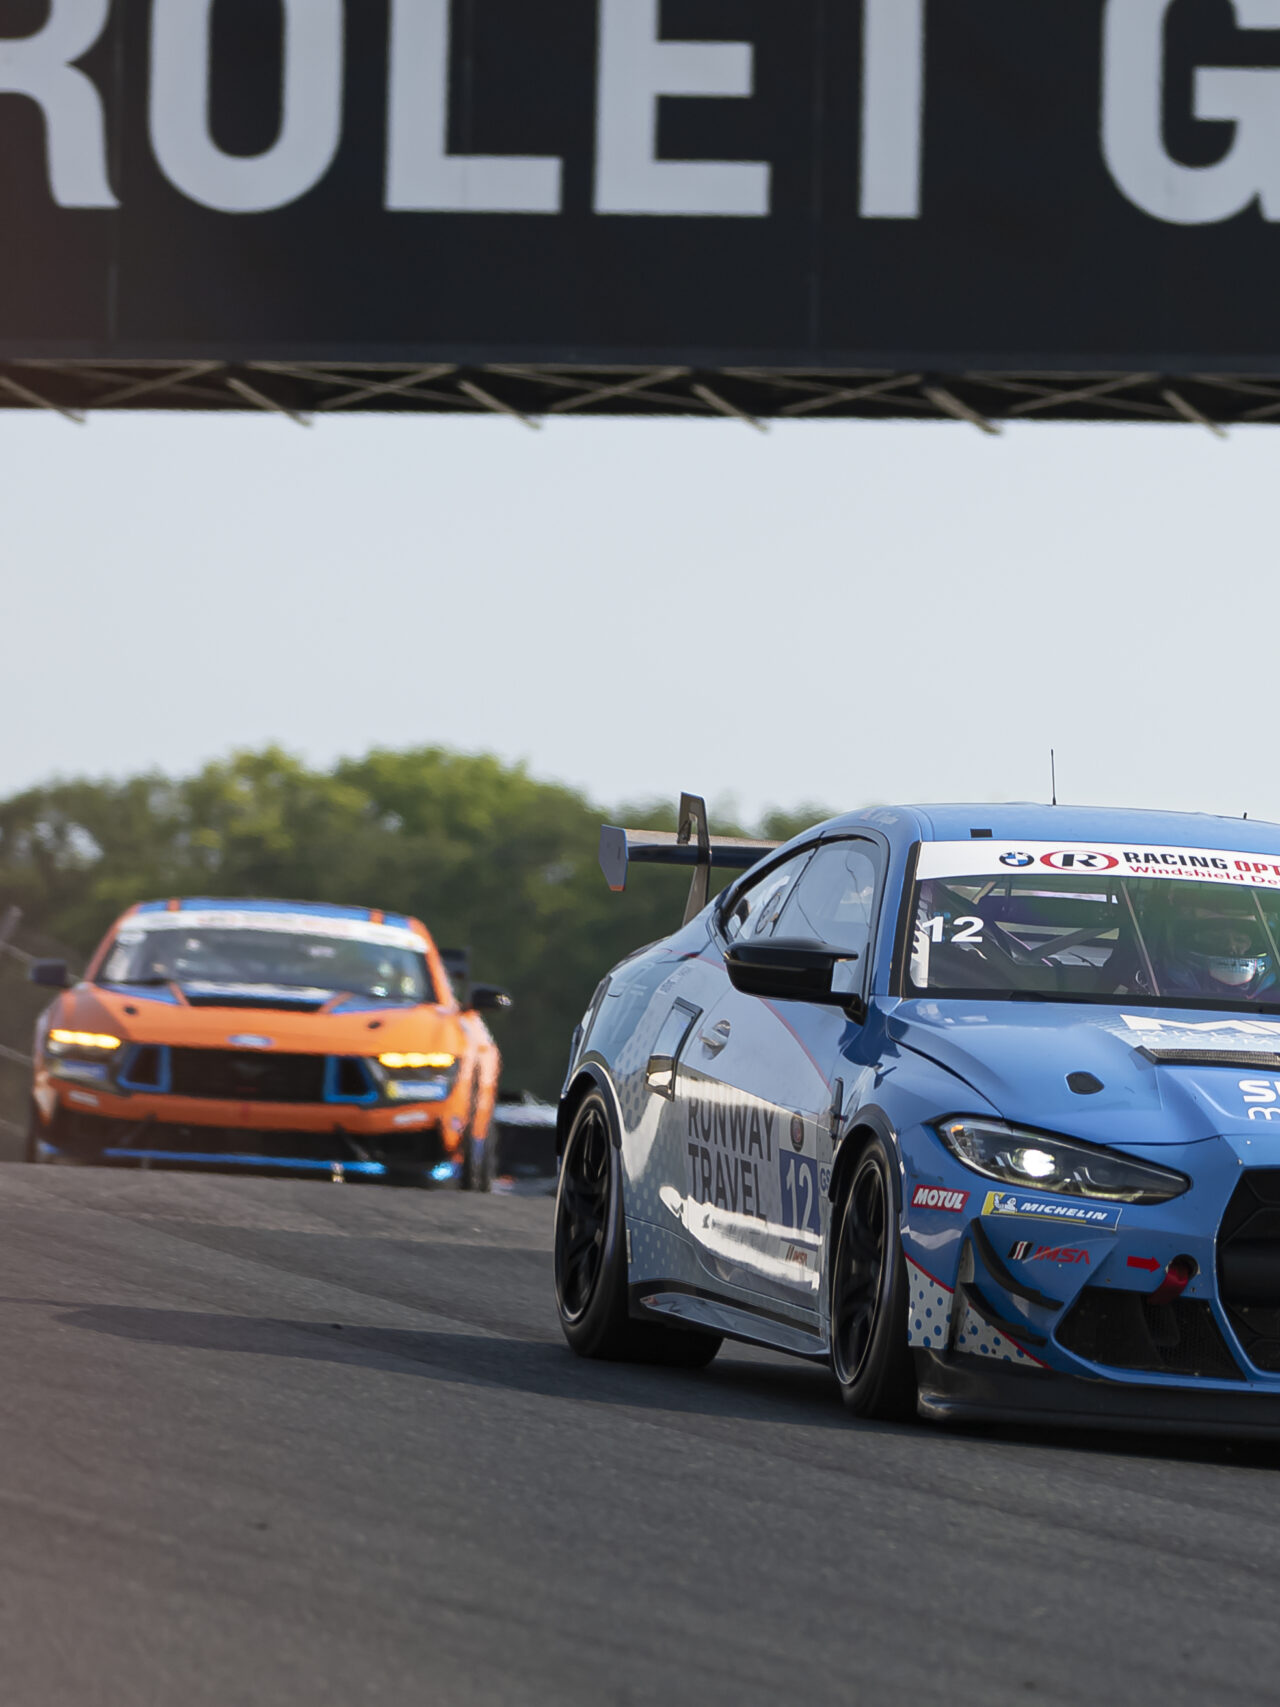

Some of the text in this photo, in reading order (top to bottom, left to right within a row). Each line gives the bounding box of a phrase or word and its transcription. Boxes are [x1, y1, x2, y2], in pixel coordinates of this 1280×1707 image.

[1123, 852, 1228, 869] RACING
[1129, 865, 1244, 881] Windshield
[922, 916, 984, 943] 12
[688, 1097, 775, 1162] RUNWAY
[688, 1142, 767, 1222] TRAVEL
[786, 1158, 815, 1234] 12
[913, 1188, 965, 1209] MOTUL
[1020, 1202, 1108, 1220] MICHELIN
